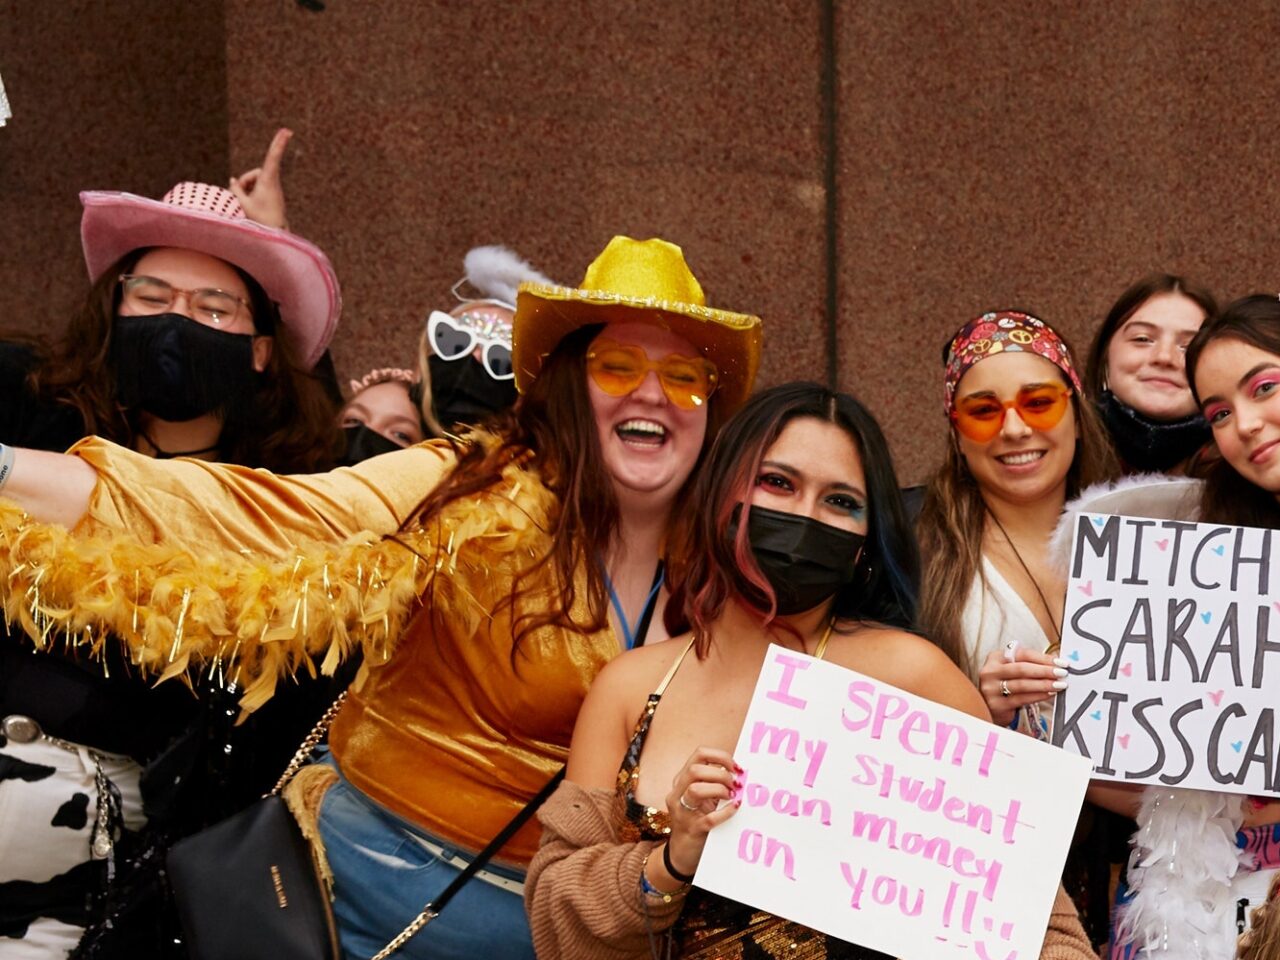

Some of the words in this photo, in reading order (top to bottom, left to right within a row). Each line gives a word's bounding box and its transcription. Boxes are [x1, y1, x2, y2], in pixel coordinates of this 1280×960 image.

[1072, 514, 1272, 595] MITCH
[765, 653, 812, 711] I
[749, 720, 829, 788] my
[737, 828, 798, 881] on
[851, 809, 1003, 902] money
